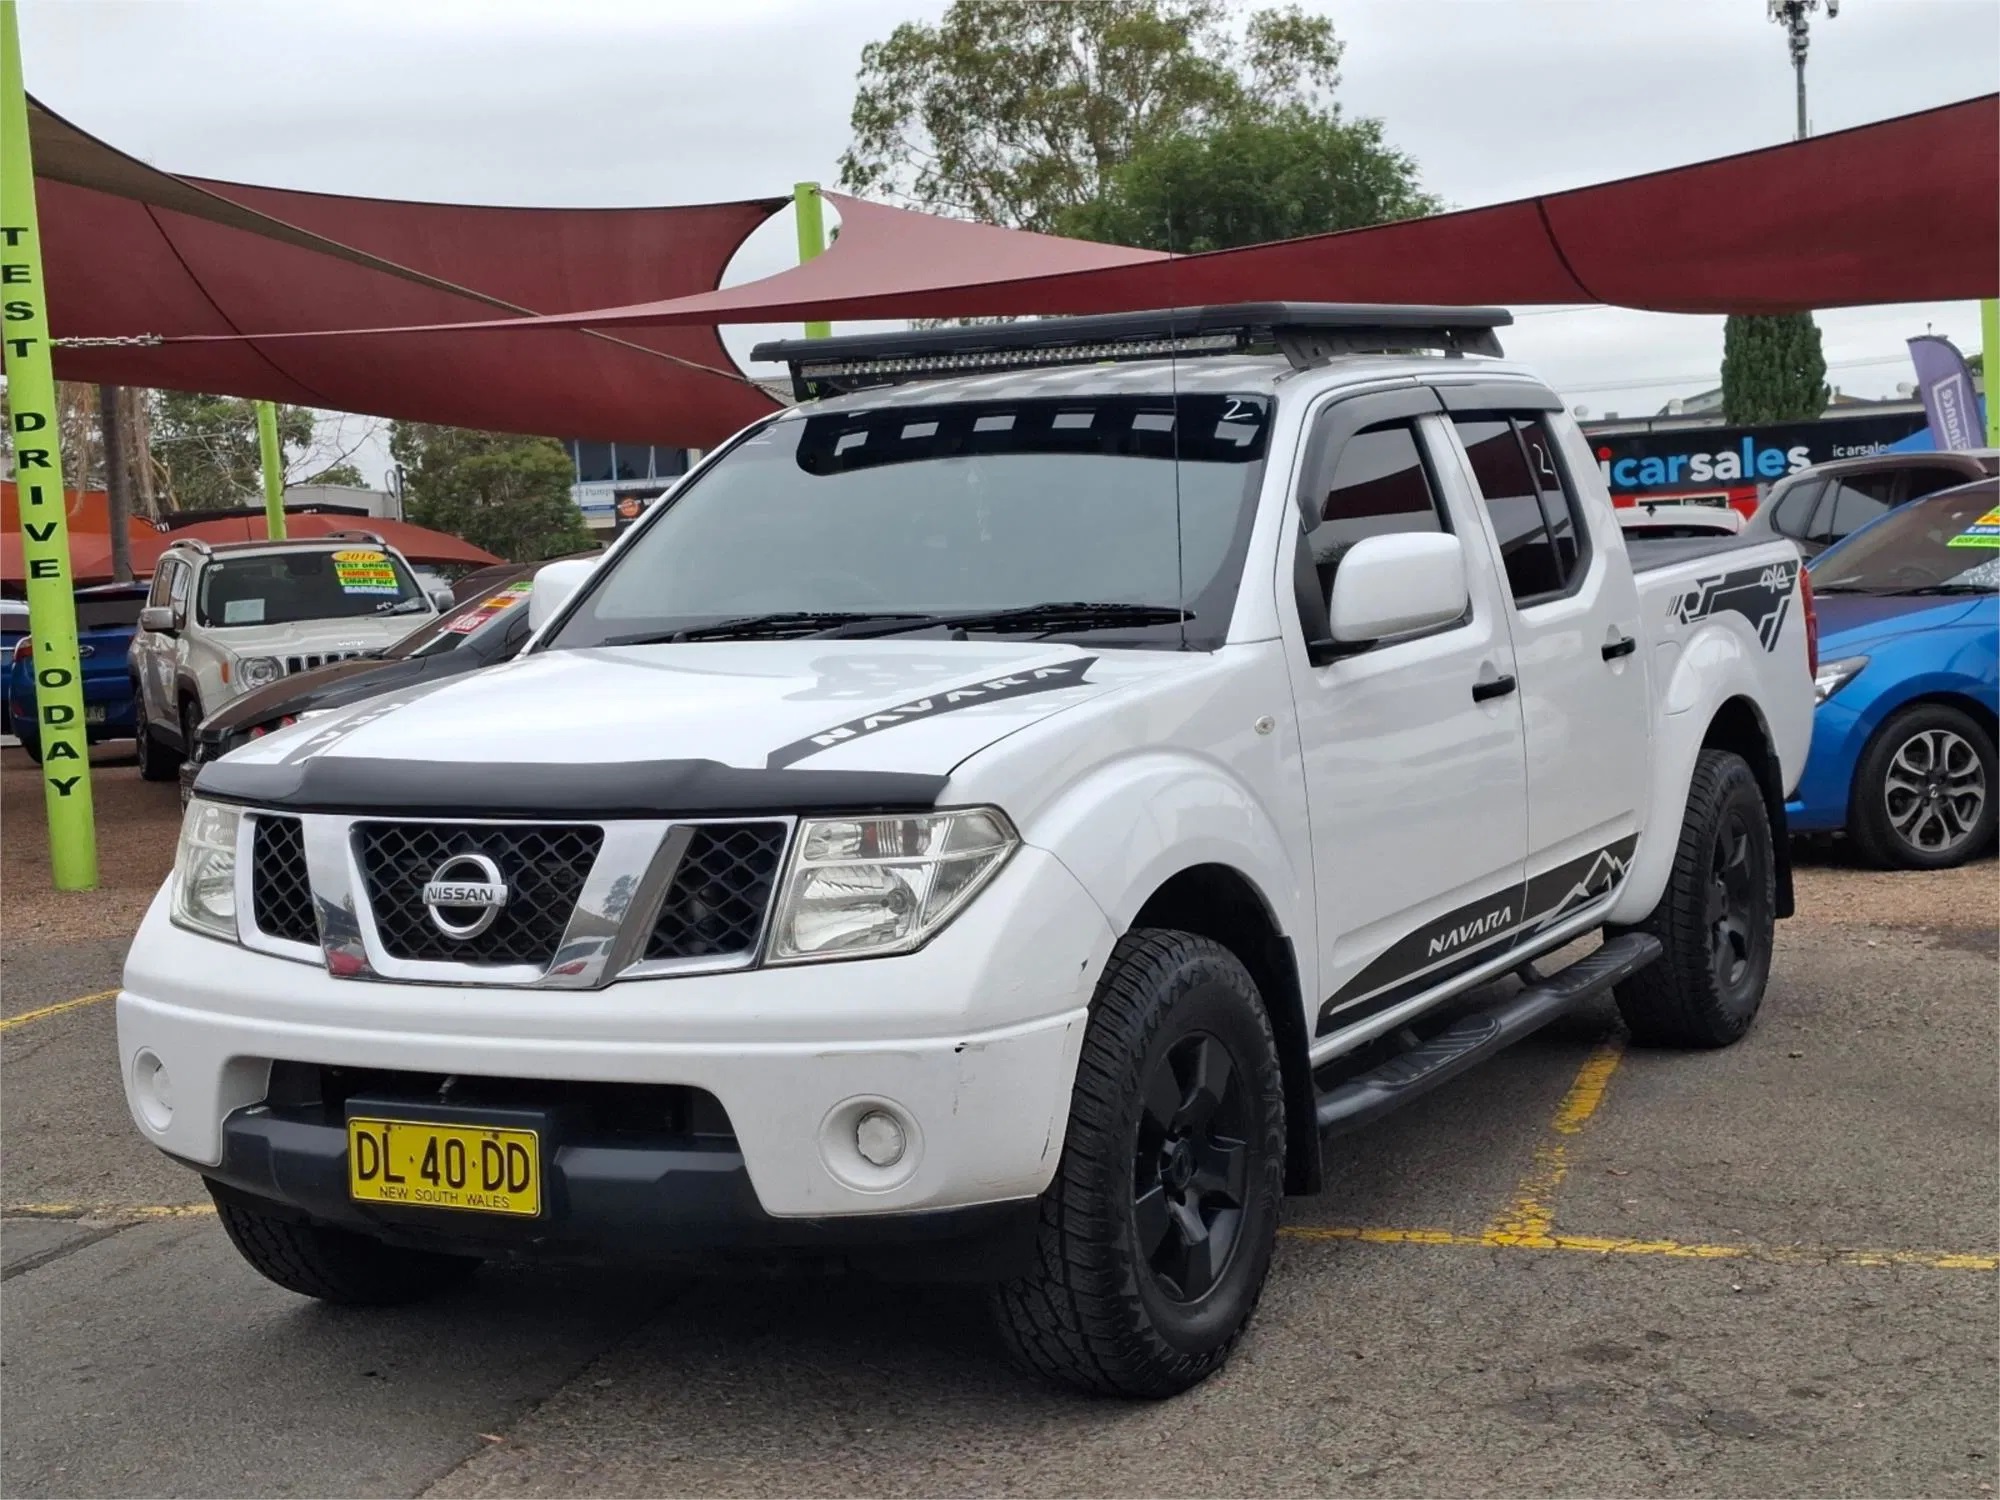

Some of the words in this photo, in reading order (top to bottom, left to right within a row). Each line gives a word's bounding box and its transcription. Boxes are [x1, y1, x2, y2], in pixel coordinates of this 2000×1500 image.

[1, 227, 38, 358] TEST
[1223, 399, 1254, 420] 2
[1598, 436, 1810, 487] icarsales
[15, 412, 61, 579] DRIVE
[343, 552, 376, 560] 2016
[38, 641, 82, 797] ODAY
[810, 666, 1073, 747] NAVARA
[428, 887, 493, 902] NISSAN
[1428, 905, 1512, 957] NAVARA
[356, 1131, 405, 1184] DL
[420, 1136, 466, 1189] 40
[482, 1140, 530, 1194] DD
[379, 1186, 408, 1200] NEW
[415, 1188, 459, 1202] SOUTH
[467, 1194, 510, 1208] WALES
